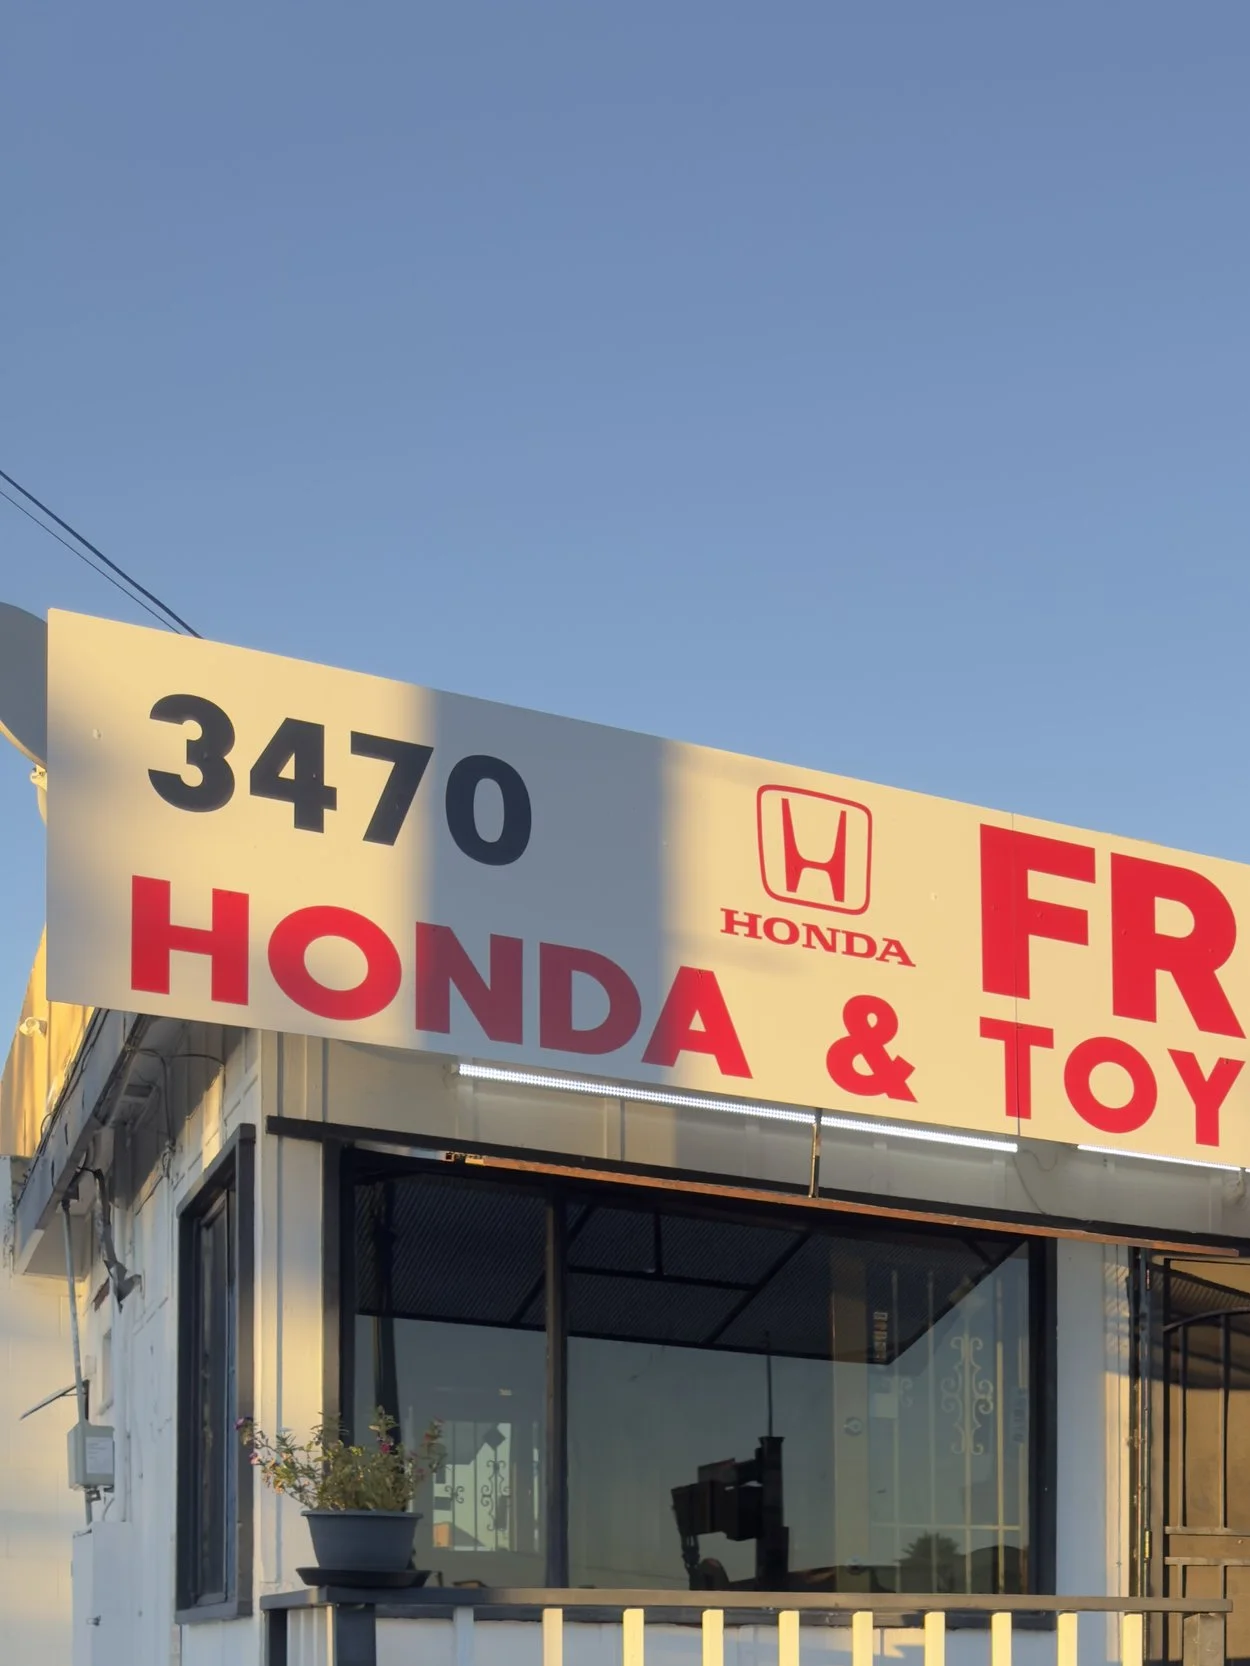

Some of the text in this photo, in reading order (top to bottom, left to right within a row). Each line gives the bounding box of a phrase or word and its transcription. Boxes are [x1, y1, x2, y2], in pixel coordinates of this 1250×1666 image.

[148, 693, 533, 866] 3470
[129, 873, 755, 1081] HONDA
[824, 993, 919, 1104] &
[718, 906, 918, 969] HONDA
